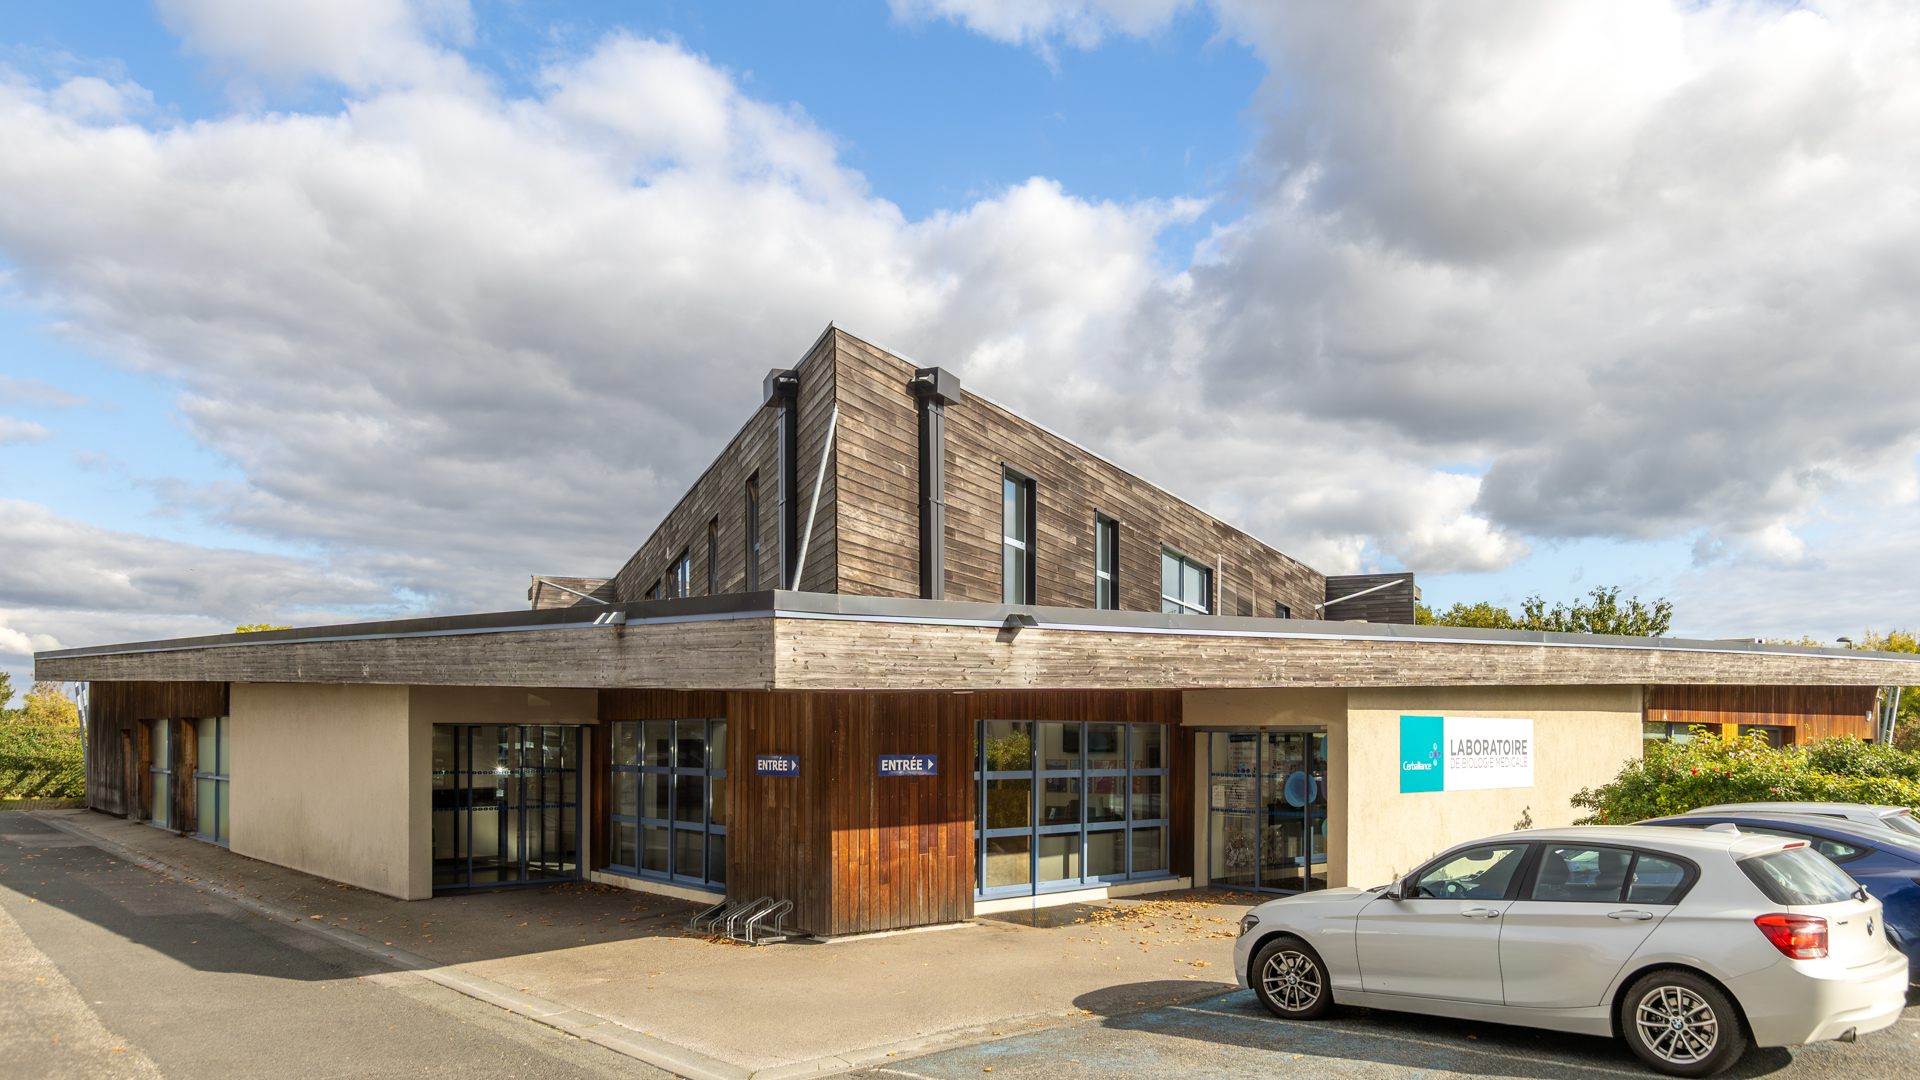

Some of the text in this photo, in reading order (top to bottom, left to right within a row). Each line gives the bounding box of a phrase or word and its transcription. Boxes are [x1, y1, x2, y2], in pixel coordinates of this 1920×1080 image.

[1450, 739, 1528, 756] LABORATOIRE
[757, 756, 788, 771] ENTRÉE
[881, 756, 923, 771] ENTRÉE
[1450, 758, 1460, 769] DE
[1462, 757, 1494, 769] BIOLOGIE
